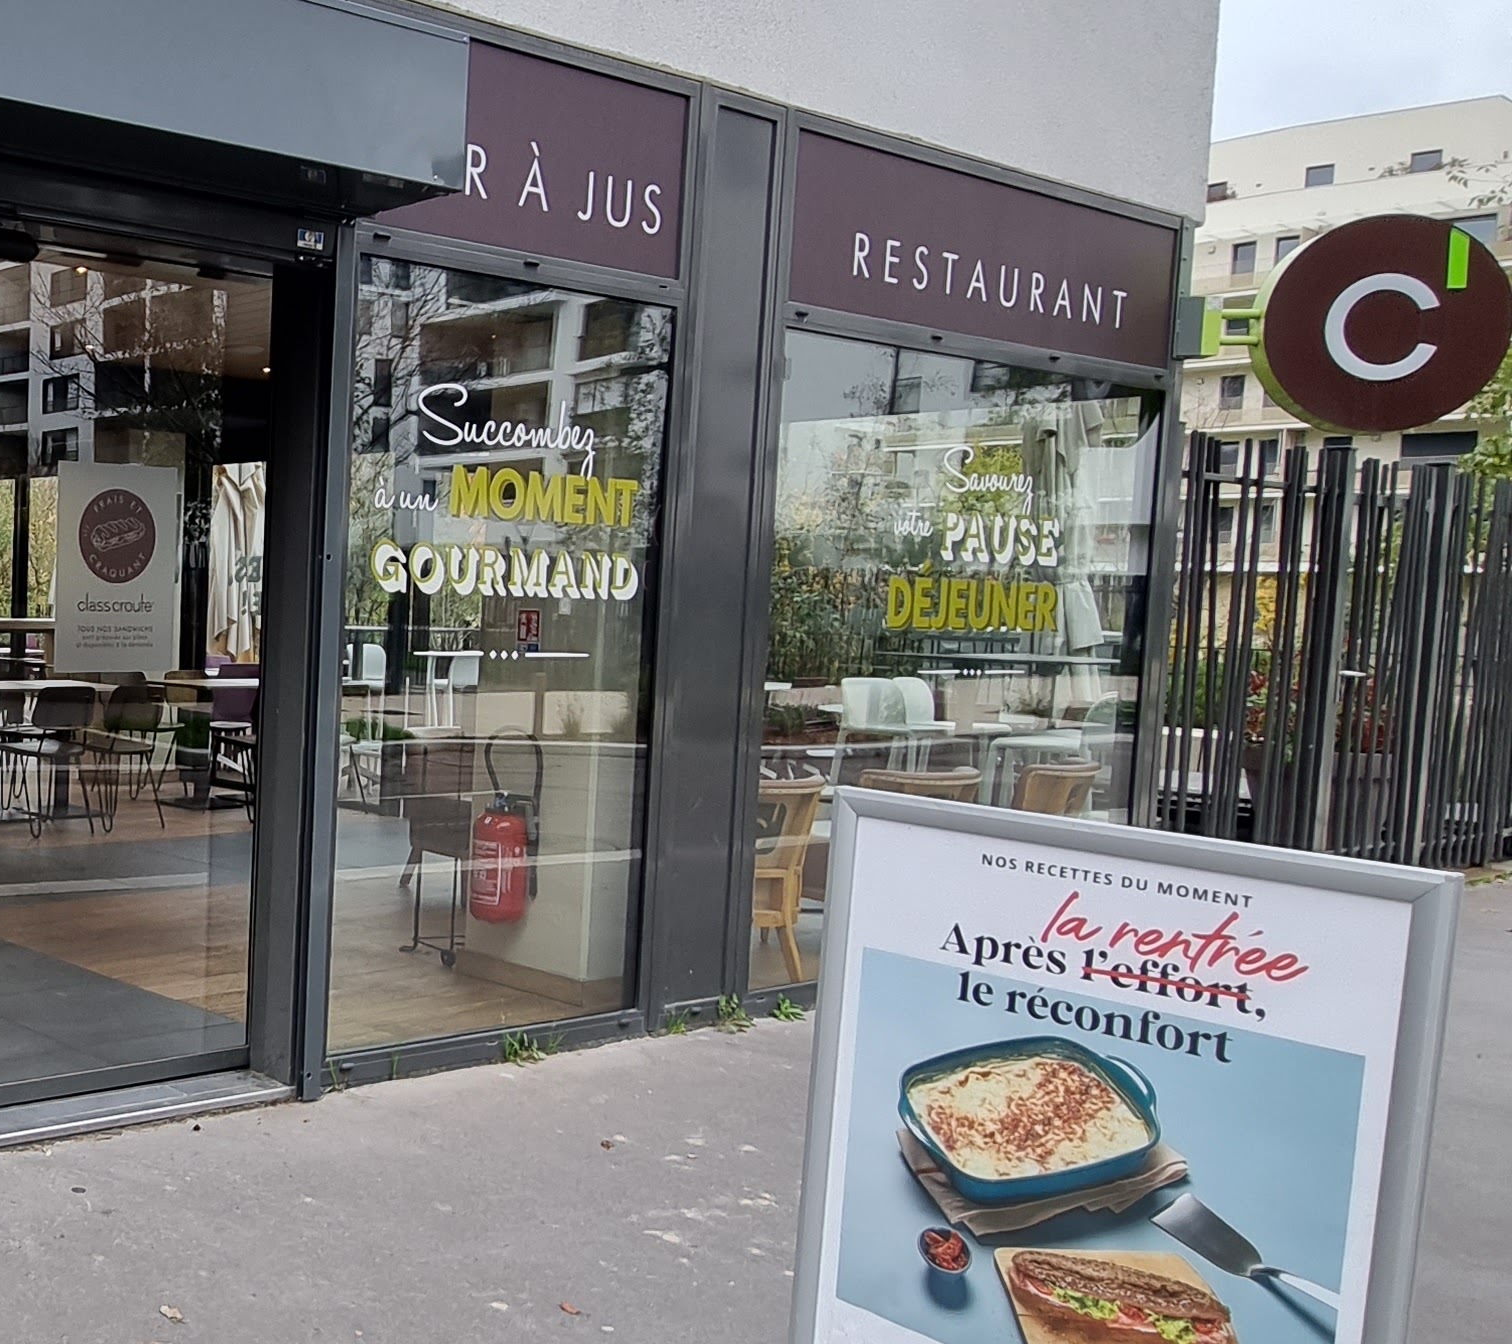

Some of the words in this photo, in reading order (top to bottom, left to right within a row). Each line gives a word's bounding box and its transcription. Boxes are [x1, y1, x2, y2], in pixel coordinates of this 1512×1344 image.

[517, 141, 549, 212] À
[576, 170, 663, 236] JUS
[851, 232, 1129, 329] RESTAURANT
[417, 383, 596, 481] Succombez
[93, 494, 125, 514] FRAIS
[129, 500, 143, 514] ET
[374, 476, 396, 510] à
[399, 490, 440, 513] un
[448, 463, 639, 528] MOMENT
[943, 445, 1034, 515] Savourez
[88, 553, 147, 579] CRAQUANT
[371, 537, 639, 601] GOURMAND
[893, 511, 934, 537] votre
[939, 510, 1060, 567] PAUSE
[886, 560, 1059, 632] DÉJEUNER
[981, 853, 1018, 871] NOS
[1024, 859, 1114, 887] RECETTES
[1120, 874, 1149, 892] DU
[1156, 880, 1254, 909] MOMENT
[939, 922, 1067, 977] Après
[1040, 890, 1103, 944] la
[1108, 911, 1310, 983] rentrée
[956, 970, 995, 1007] le
[1005, 986, 1233, 1064] réconfort
